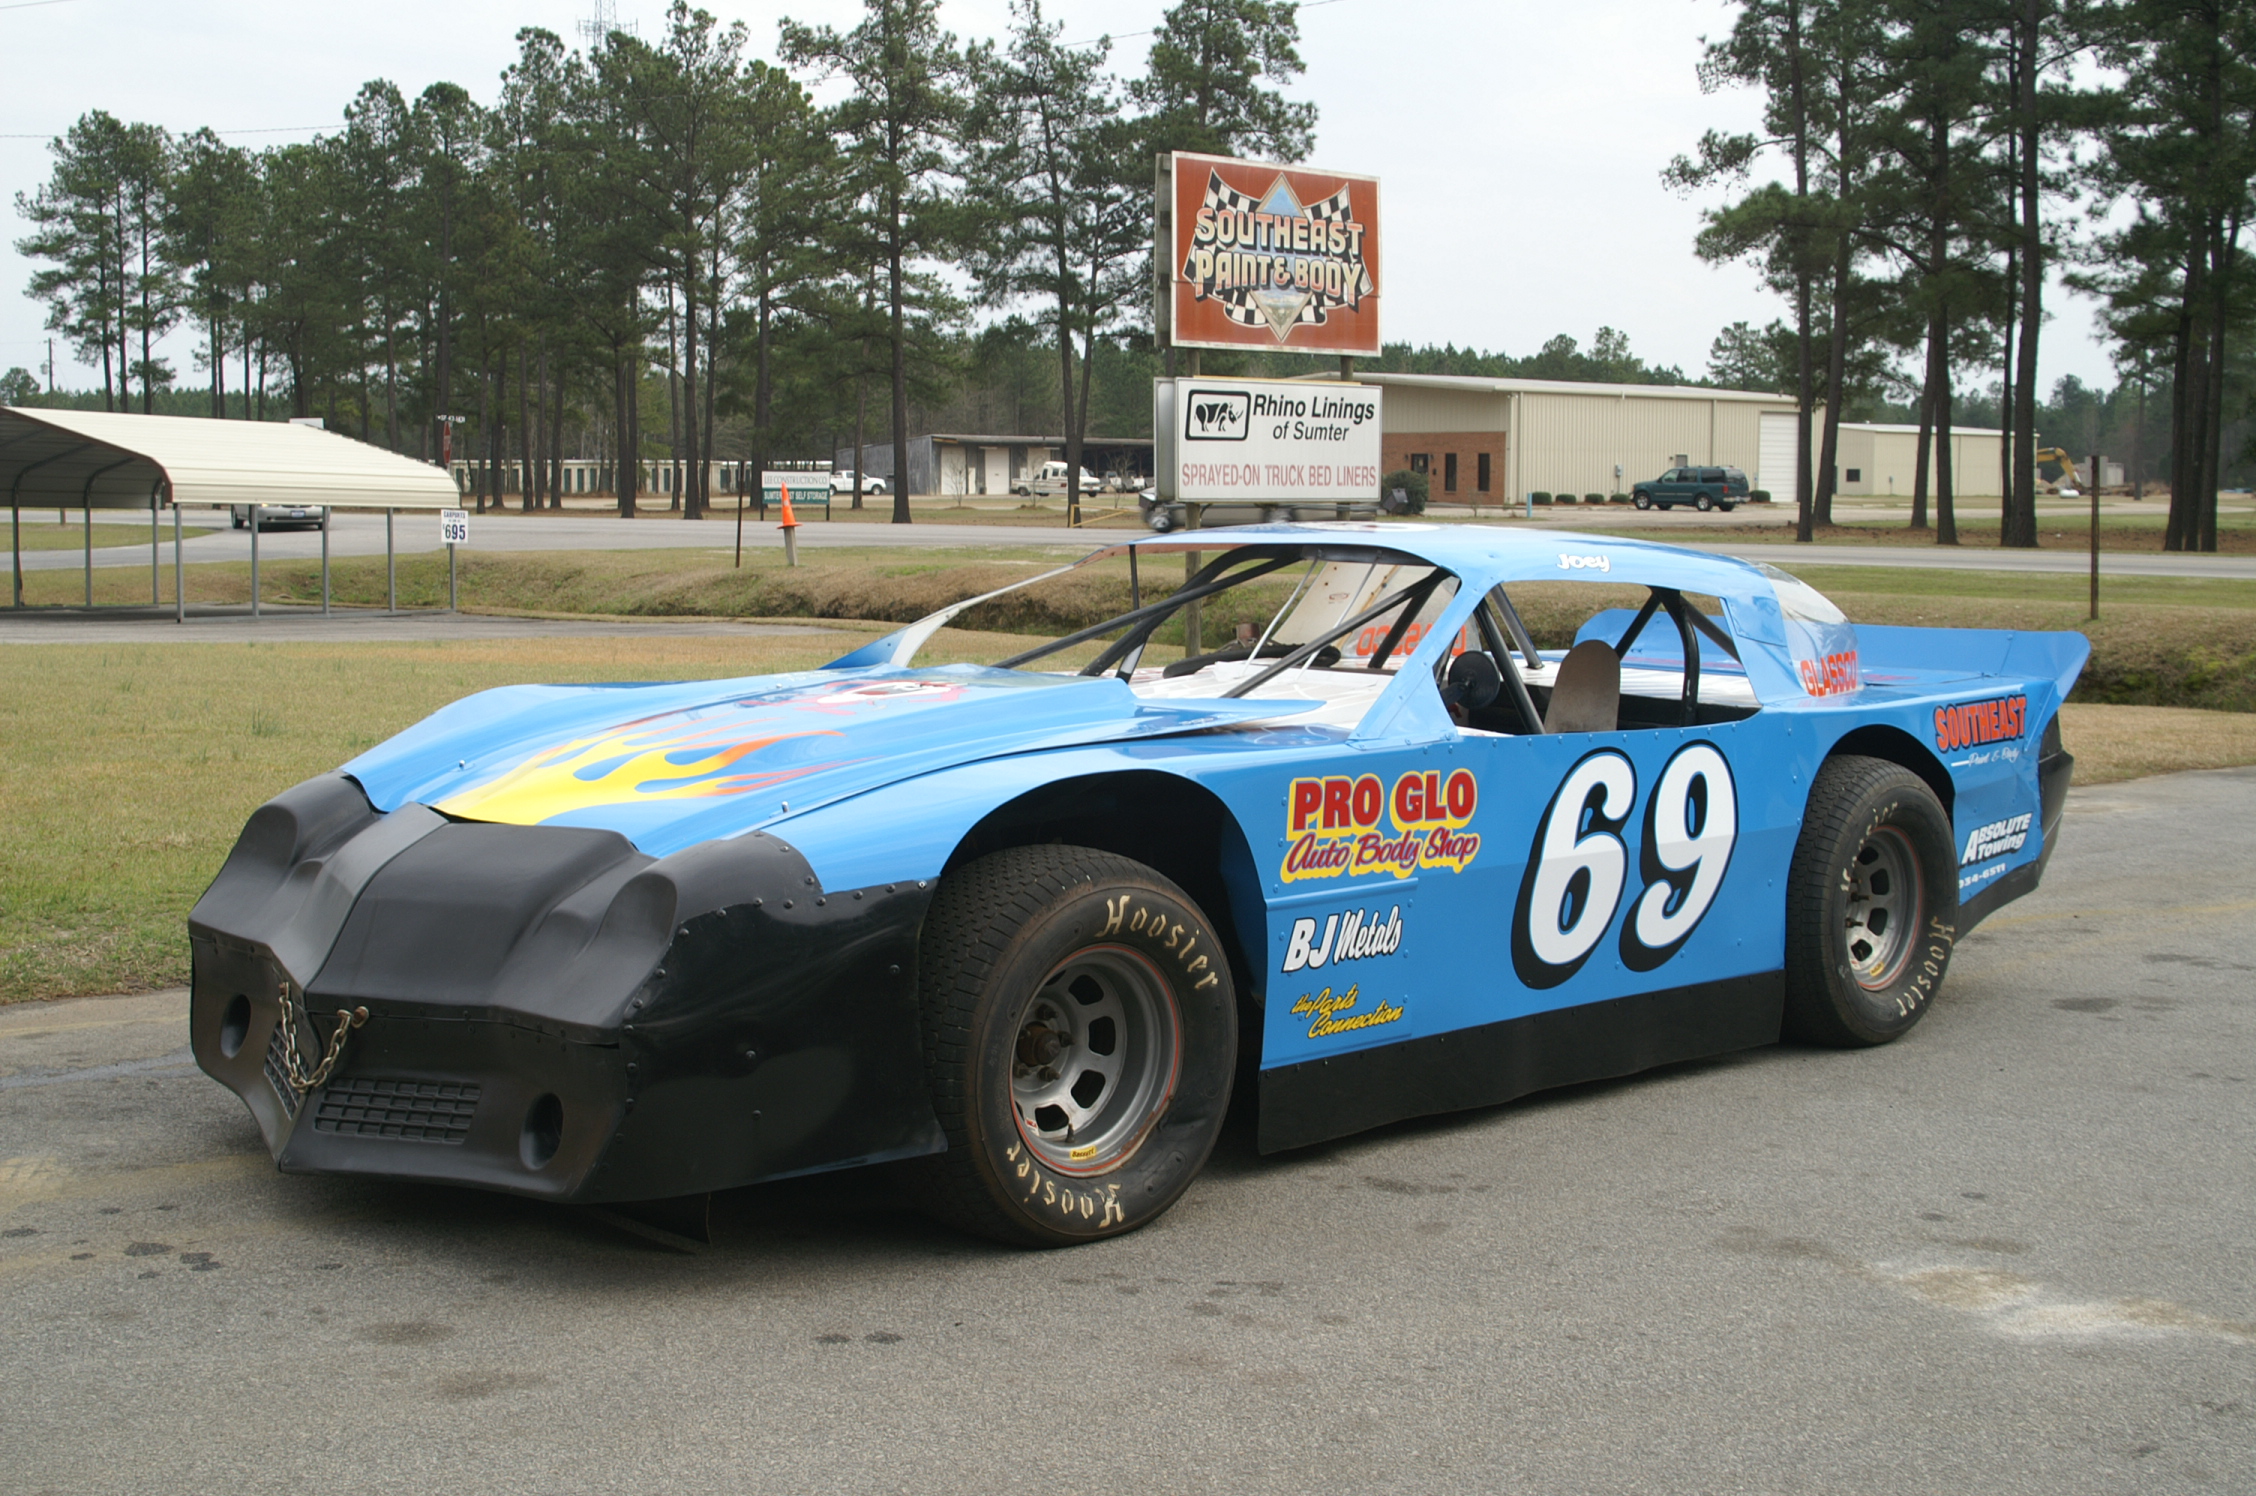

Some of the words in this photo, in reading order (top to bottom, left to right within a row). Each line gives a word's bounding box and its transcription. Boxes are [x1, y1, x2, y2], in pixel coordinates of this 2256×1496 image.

[1195, 206, 1364, 255] SOUTHEAST
[1195, 250, 1272, 297] PAINT
[1294, 258, 1362, 307] BODY
[1253, 394, 1306, 418] Rhino
[1311, 396, 1375, 425] Linings
[1272, 421, 1290, 440] of
[1293, 421, 1350, 441] Sumter
[1182, 463, 1261, 487] SPRAYED-ON
[1265, 464, 1305, 487] TRUCK
[1309, 465, 1332, 487] BED
[1337, 466, 1376, 487] LINERS
[1556, 553, 1611, 573] Joey
[1800, 650, 1857, 697] GLASSCO
[1933, 694, 2027, 754] SOUTHEAST
[1289, 774, 1383, 837] PRO
[1391, 769, 1478, 831] GLO
[1284, 831, 1352, 877] Auto
[1353, 829, 1421, 873] Body
[1422, 825, 1479, 867] Shop
[1511, 739, 1739, 988] 69
[1960, 812, 2033, 867] ABSOLUTE
[1095, 895, 1219, 990] Hoosier
[1281, 912, 1340, 973] BJ
[1333, 904, 1403, 966] Metals
[1896, 915, 1956, 1018] Hoosier
[1305, 983, 1359, 1019] Parts
[1307, 999, 1404, 1039] Connection
[1006, 1140, 1125, 1228] Hoosier
